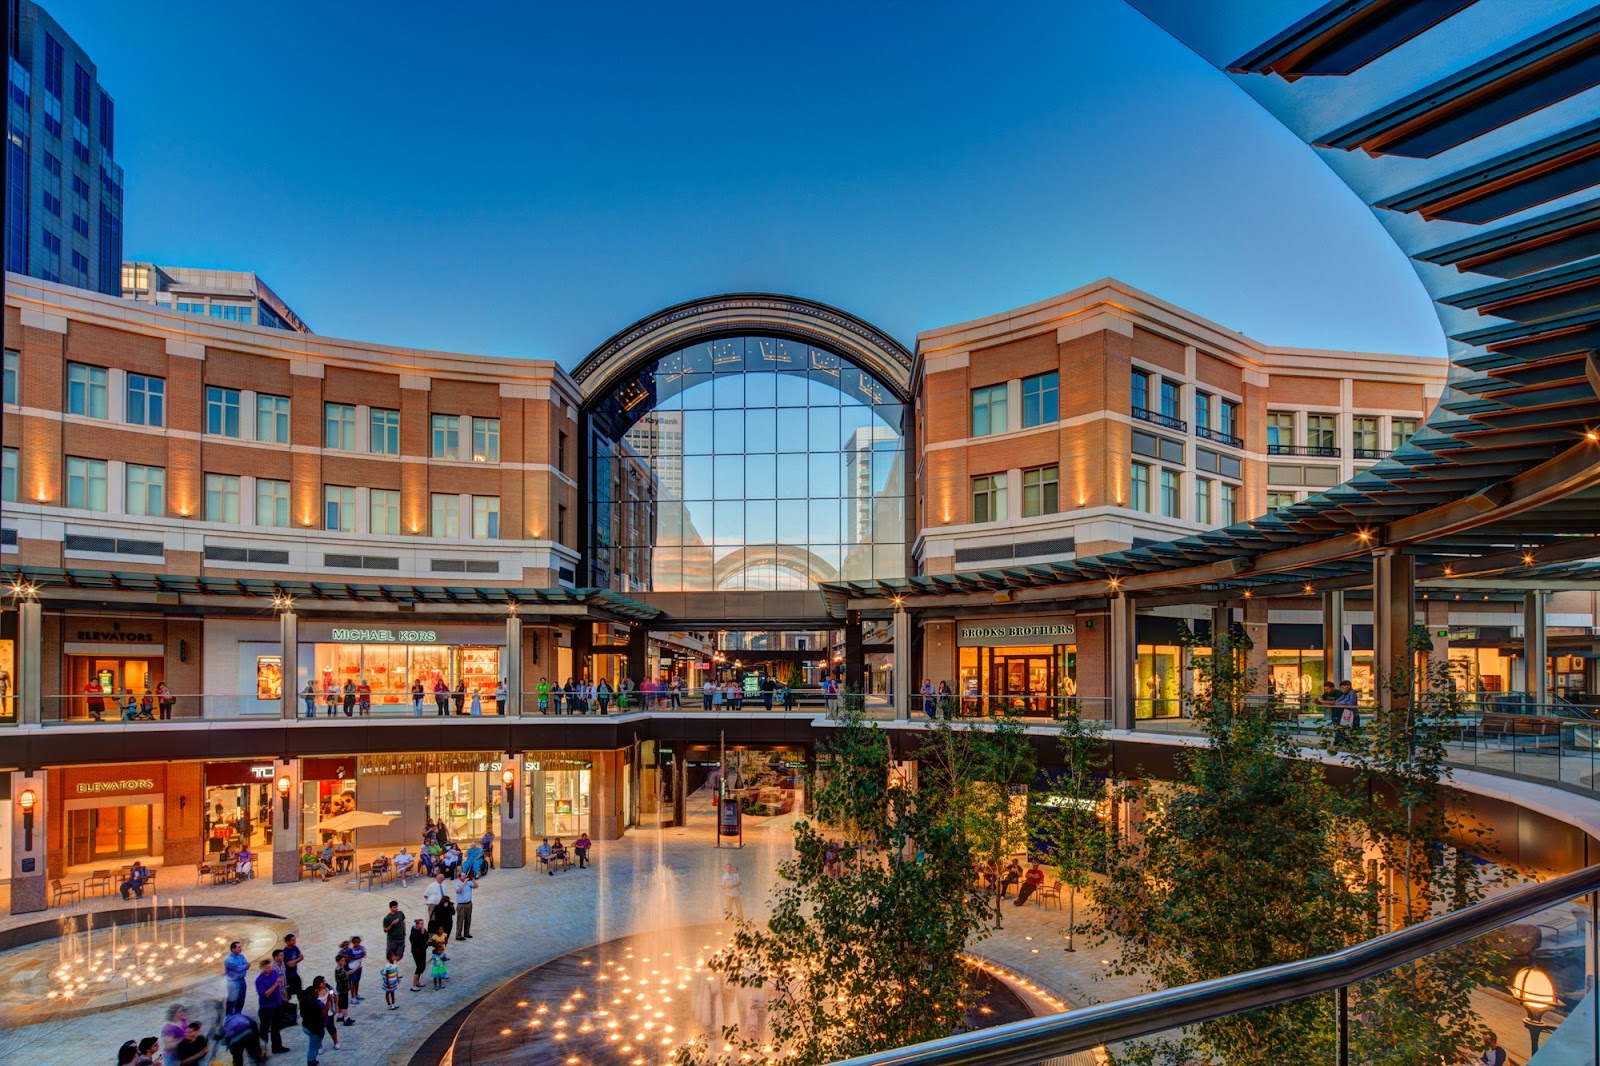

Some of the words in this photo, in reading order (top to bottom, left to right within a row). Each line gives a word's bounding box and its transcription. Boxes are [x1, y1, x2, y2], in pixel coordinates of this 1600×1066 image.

[77, 631, 153, 641] ELEVATORS
[332, 628, 395, 641] MICHAEL
[399, 630, 436, 642] KORS
[962, 627, 1006, 638] BROOKS
[1009, 625, 1074, 636] BROTHERS
[77, 779, 154, 794] ELEVATORS
